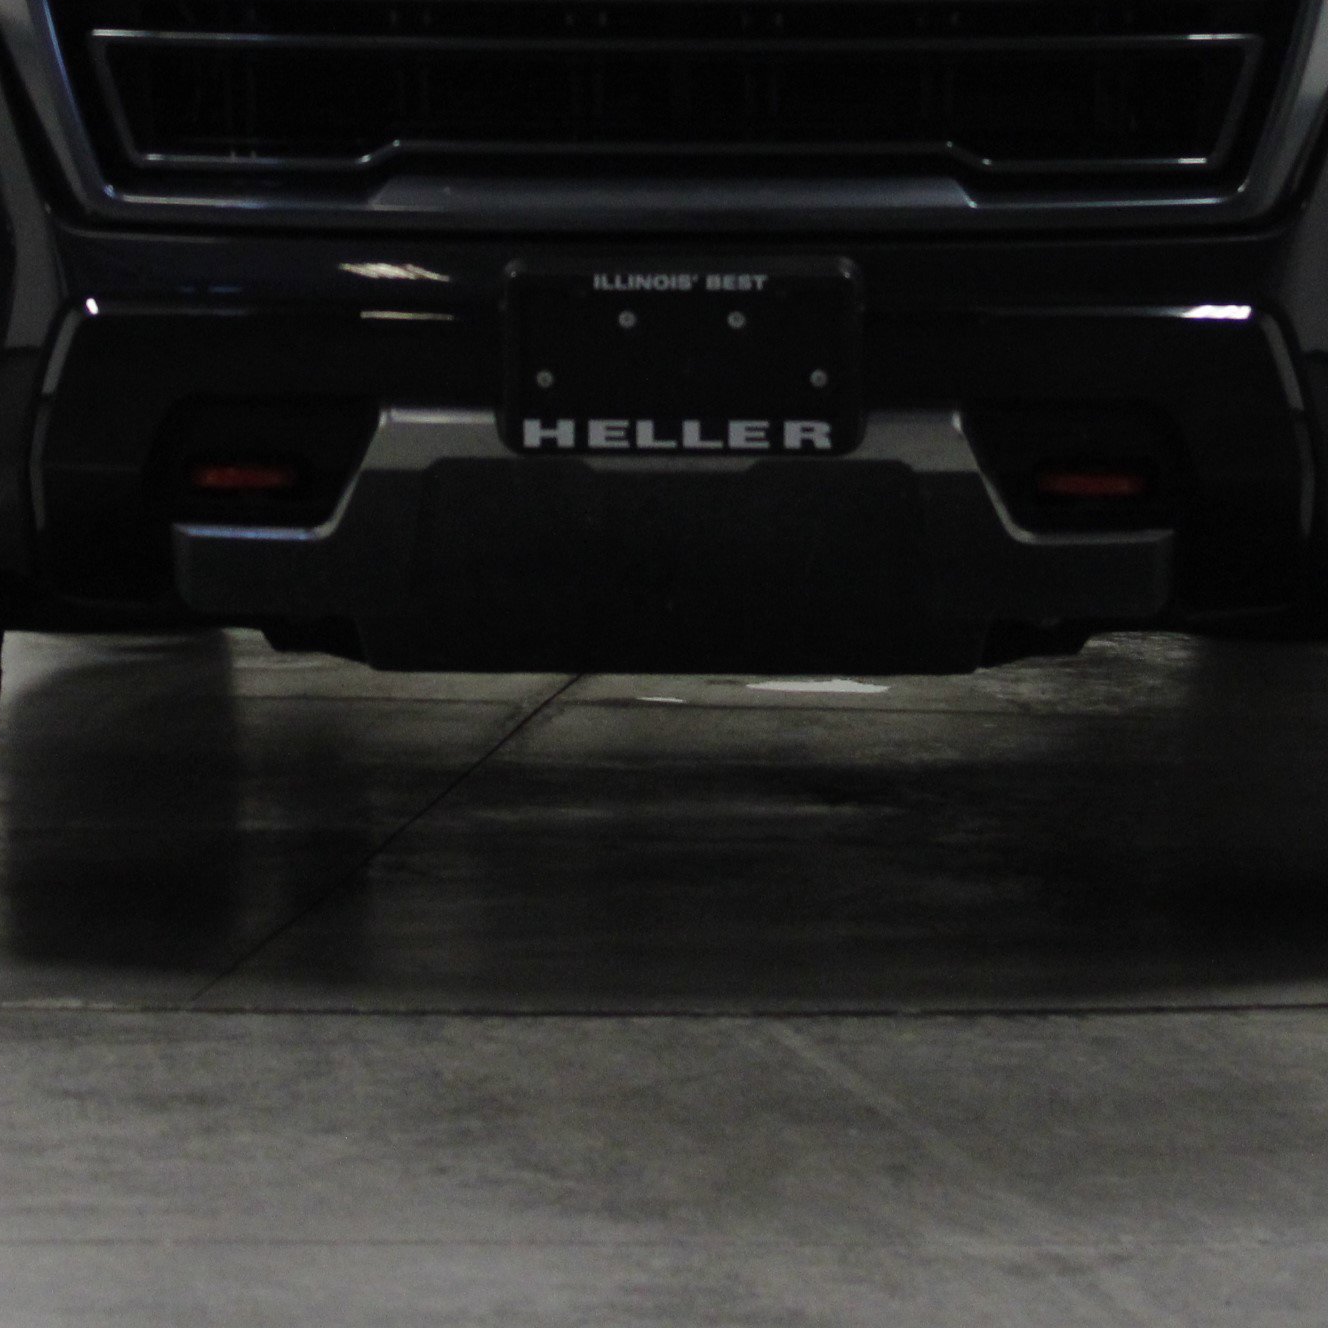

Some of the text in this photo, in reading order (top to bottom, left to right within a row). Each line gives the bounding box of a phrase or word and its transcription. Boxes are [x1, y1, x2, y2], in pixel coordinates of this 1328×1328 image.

[592, 273, 770, 291] ILLINOIS' BEST
[522, 418, 833, 450] HELLER
